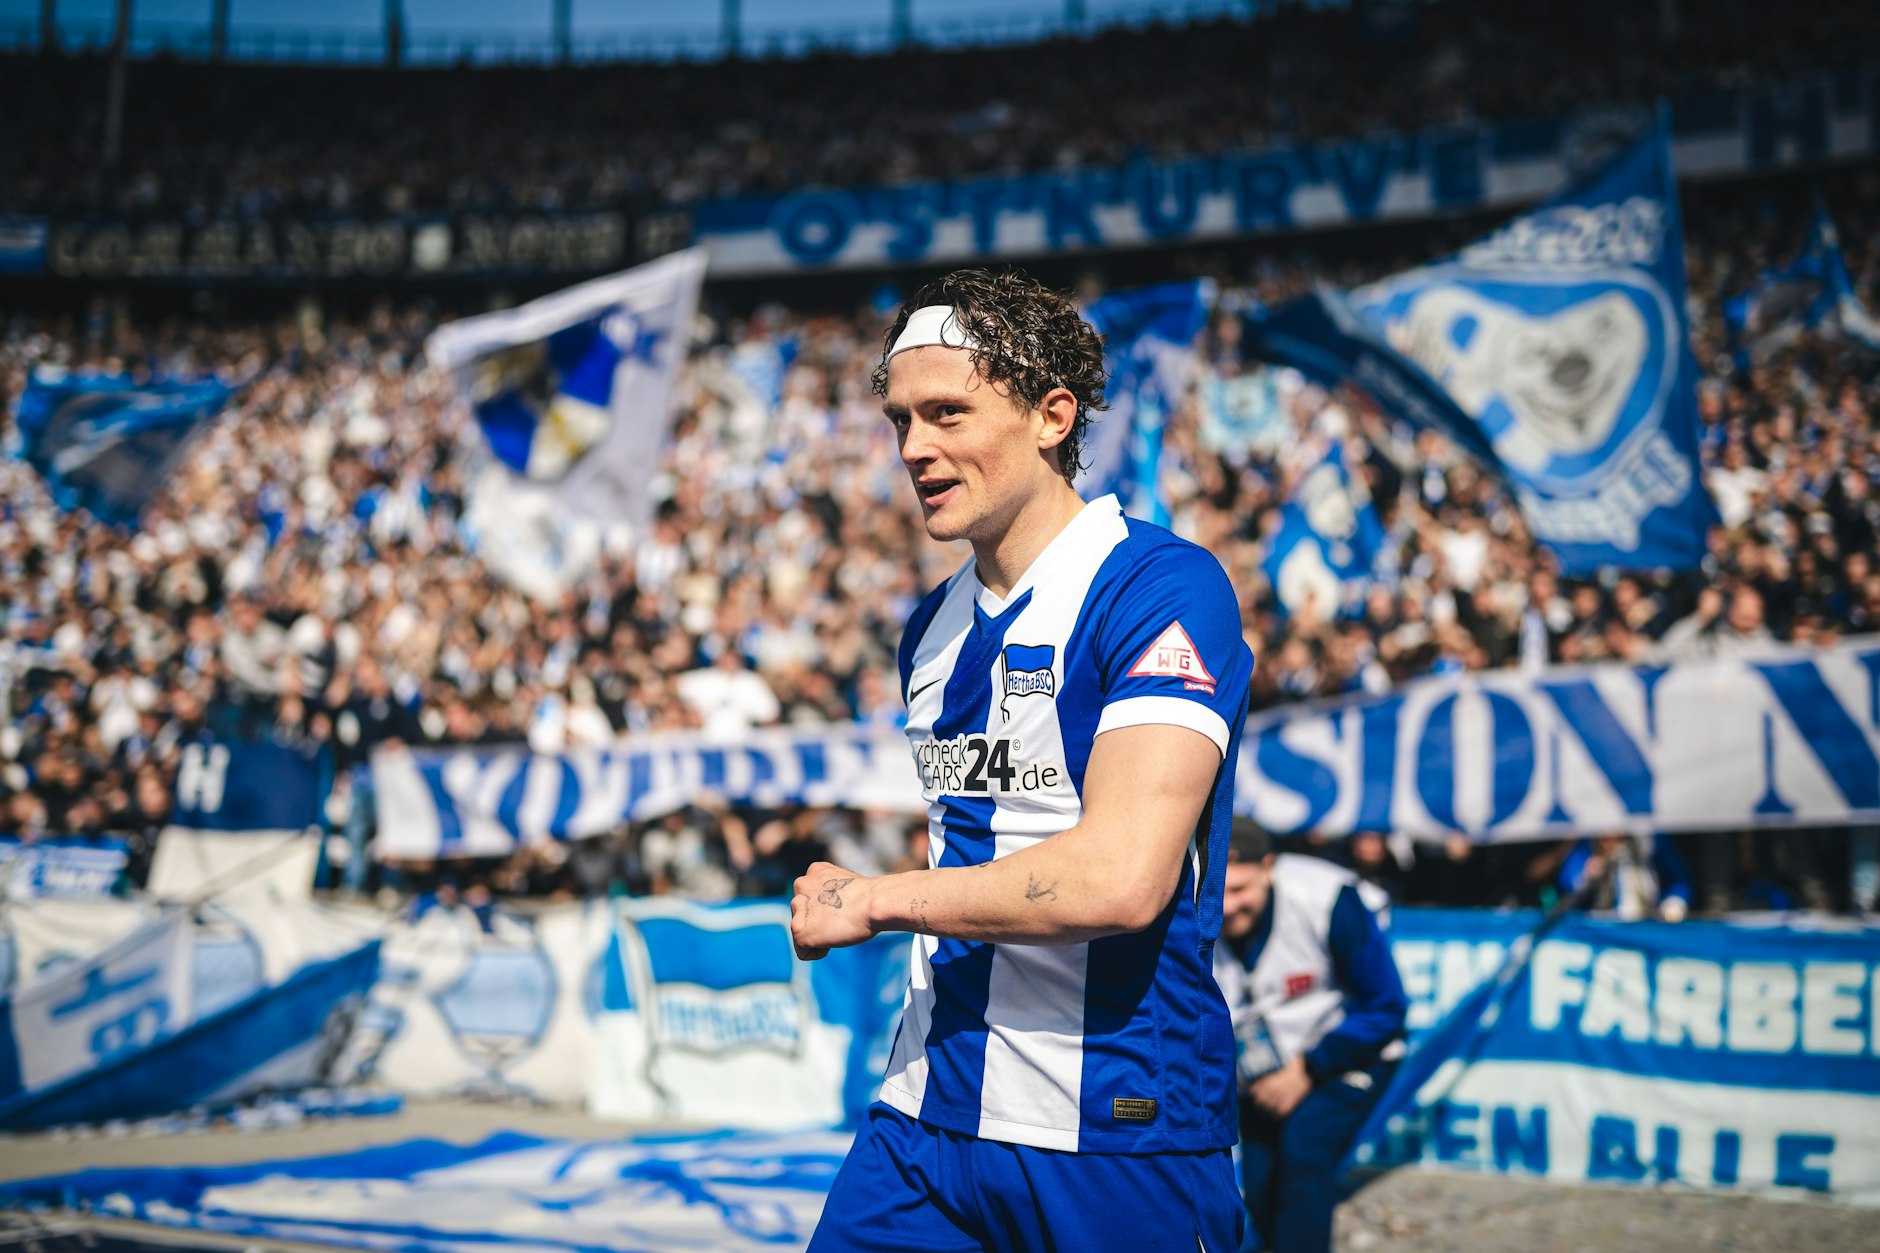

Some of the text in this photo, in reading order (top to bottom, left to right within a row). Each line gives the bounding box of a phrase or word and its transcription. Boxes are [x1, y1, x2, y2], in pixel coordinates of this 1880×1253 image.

[774, 133, 1484, 265] OSTKURVE
[922, 765, 962, 791] CARS
[1529, 938, 1880, 1055] FARBE
